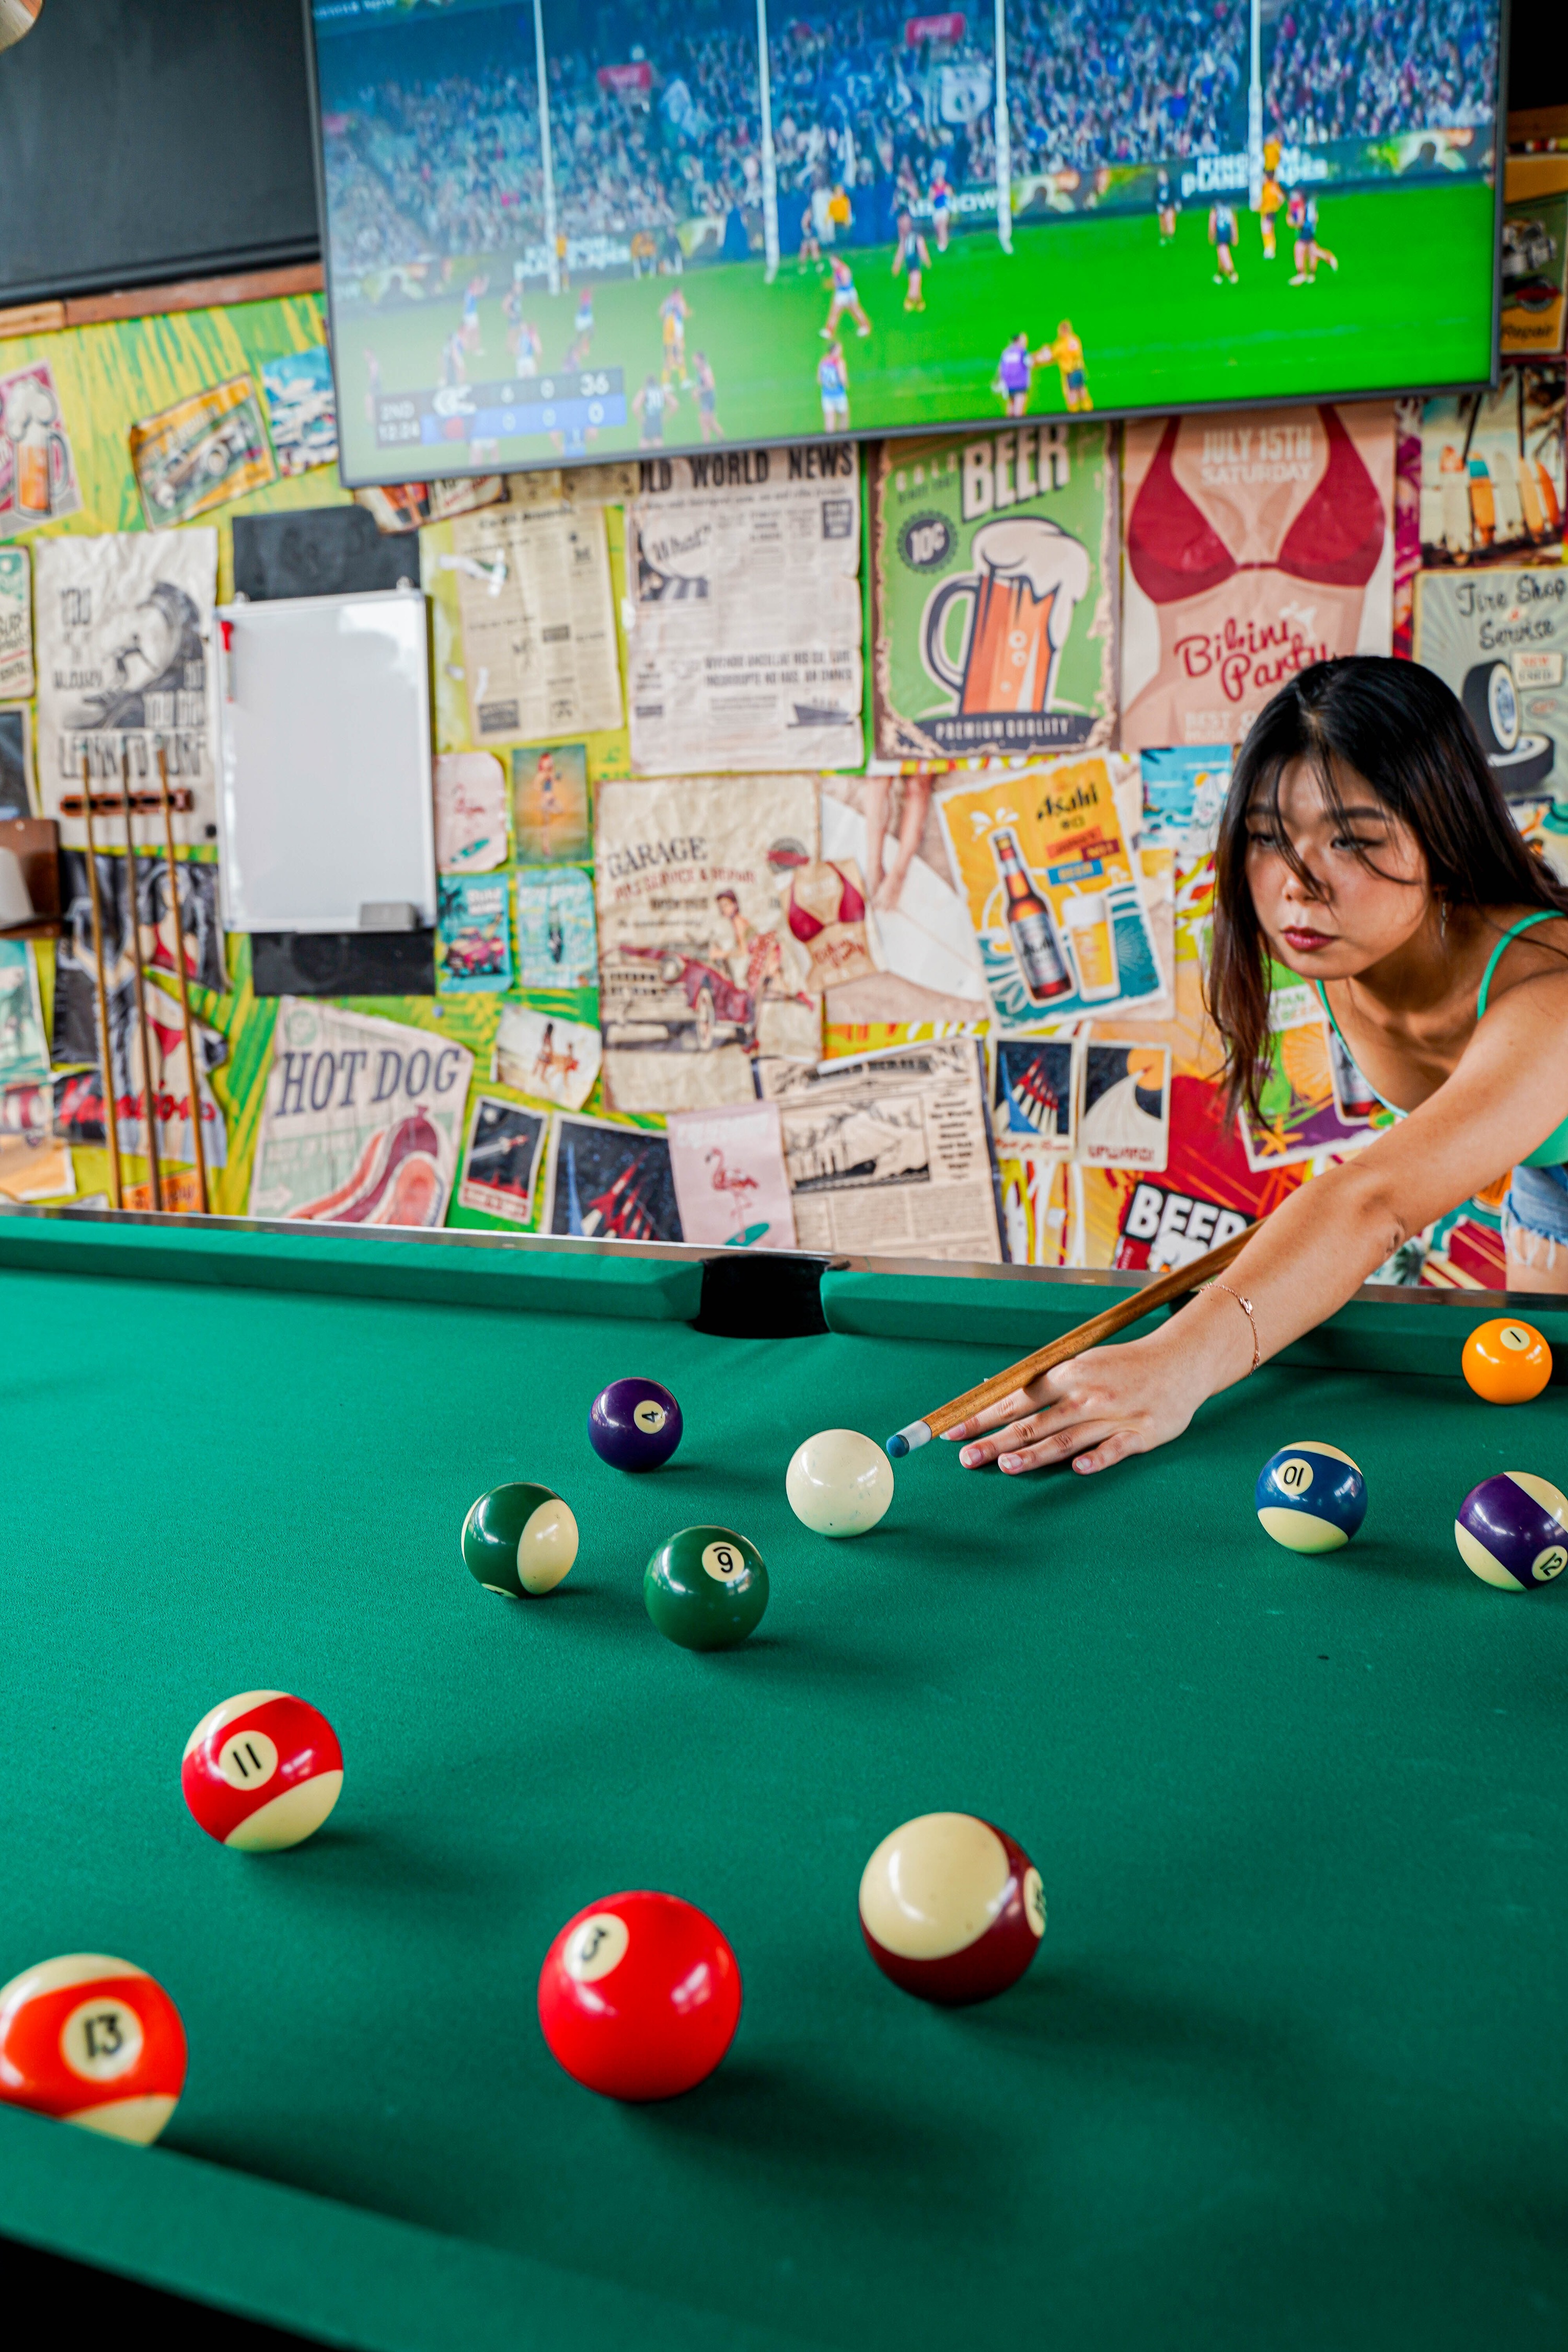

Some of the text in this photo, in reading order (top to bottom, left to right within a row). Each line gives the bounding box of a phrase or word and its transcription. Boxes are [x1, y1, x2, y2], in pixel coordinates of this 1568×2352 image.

[581, 372, 609, 397] 36
[587, 400, 604, 424] 0
[1203, 425, 1311, 464] JULY 15TH
[689, 449, 768, 489] WORLD
[789, 443, 852, 480] NEWS
[962, 424, 1069, 523] BEER
[1202, 462, 1313, 487] SATURDAY
[1456, 574, 1566, 617] Tire Shop
[1174, 618, 1289, 678] Bikini
[1479, 620, 1556, 650] Service
[935, 718, 1068, 741] PREMIUM QUALITY
[1037, 783, 1098, 819] Asahi
[607, 837, 707, 879] GARAGE
[645, 868, 695, 891] SERVICE
[711, 865, 755, 884] REPAIR
[275, 1050, 367, 1117] HOT
[371, 1047, 460, 1103] DOG
[1510, 1331, 1521, 1343] 1
[641, 1411, 659, 1423] 4
[1539, 1553, 1563, 1577] 12
[233, 1743, 261, 1778] 11
[580, 1927, 607, 1962] 3
[85, 2014, 123, 2058] 13
